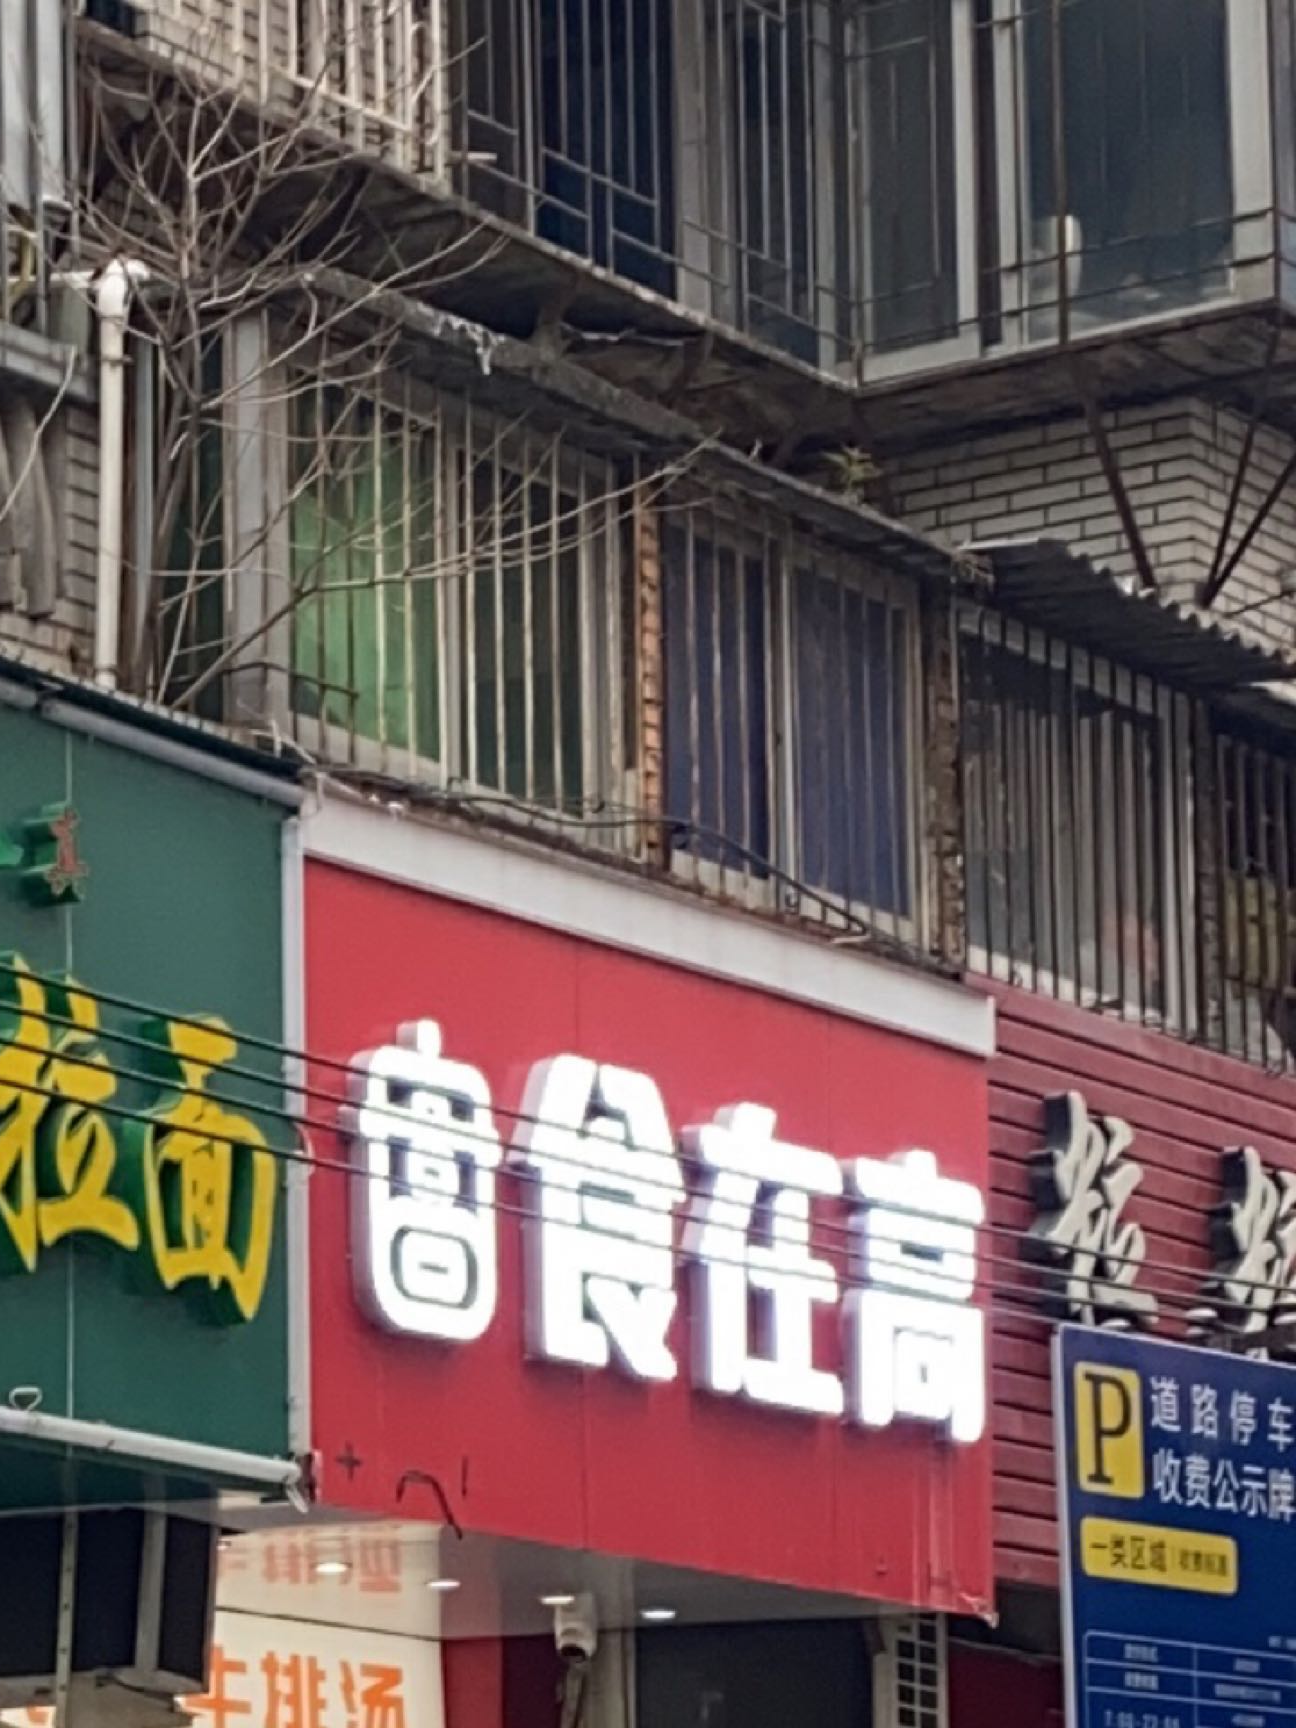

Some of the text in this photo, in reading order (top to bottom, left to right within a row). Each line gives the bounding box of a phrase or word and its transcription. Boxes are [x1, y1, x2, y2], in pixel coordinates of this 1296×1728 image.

[1084, 1370, 1132, 1485] P
[1149, 1376, 1294, 1452] 道路停车
[1152, 1448, 1296, 1522] 收费公示牌
